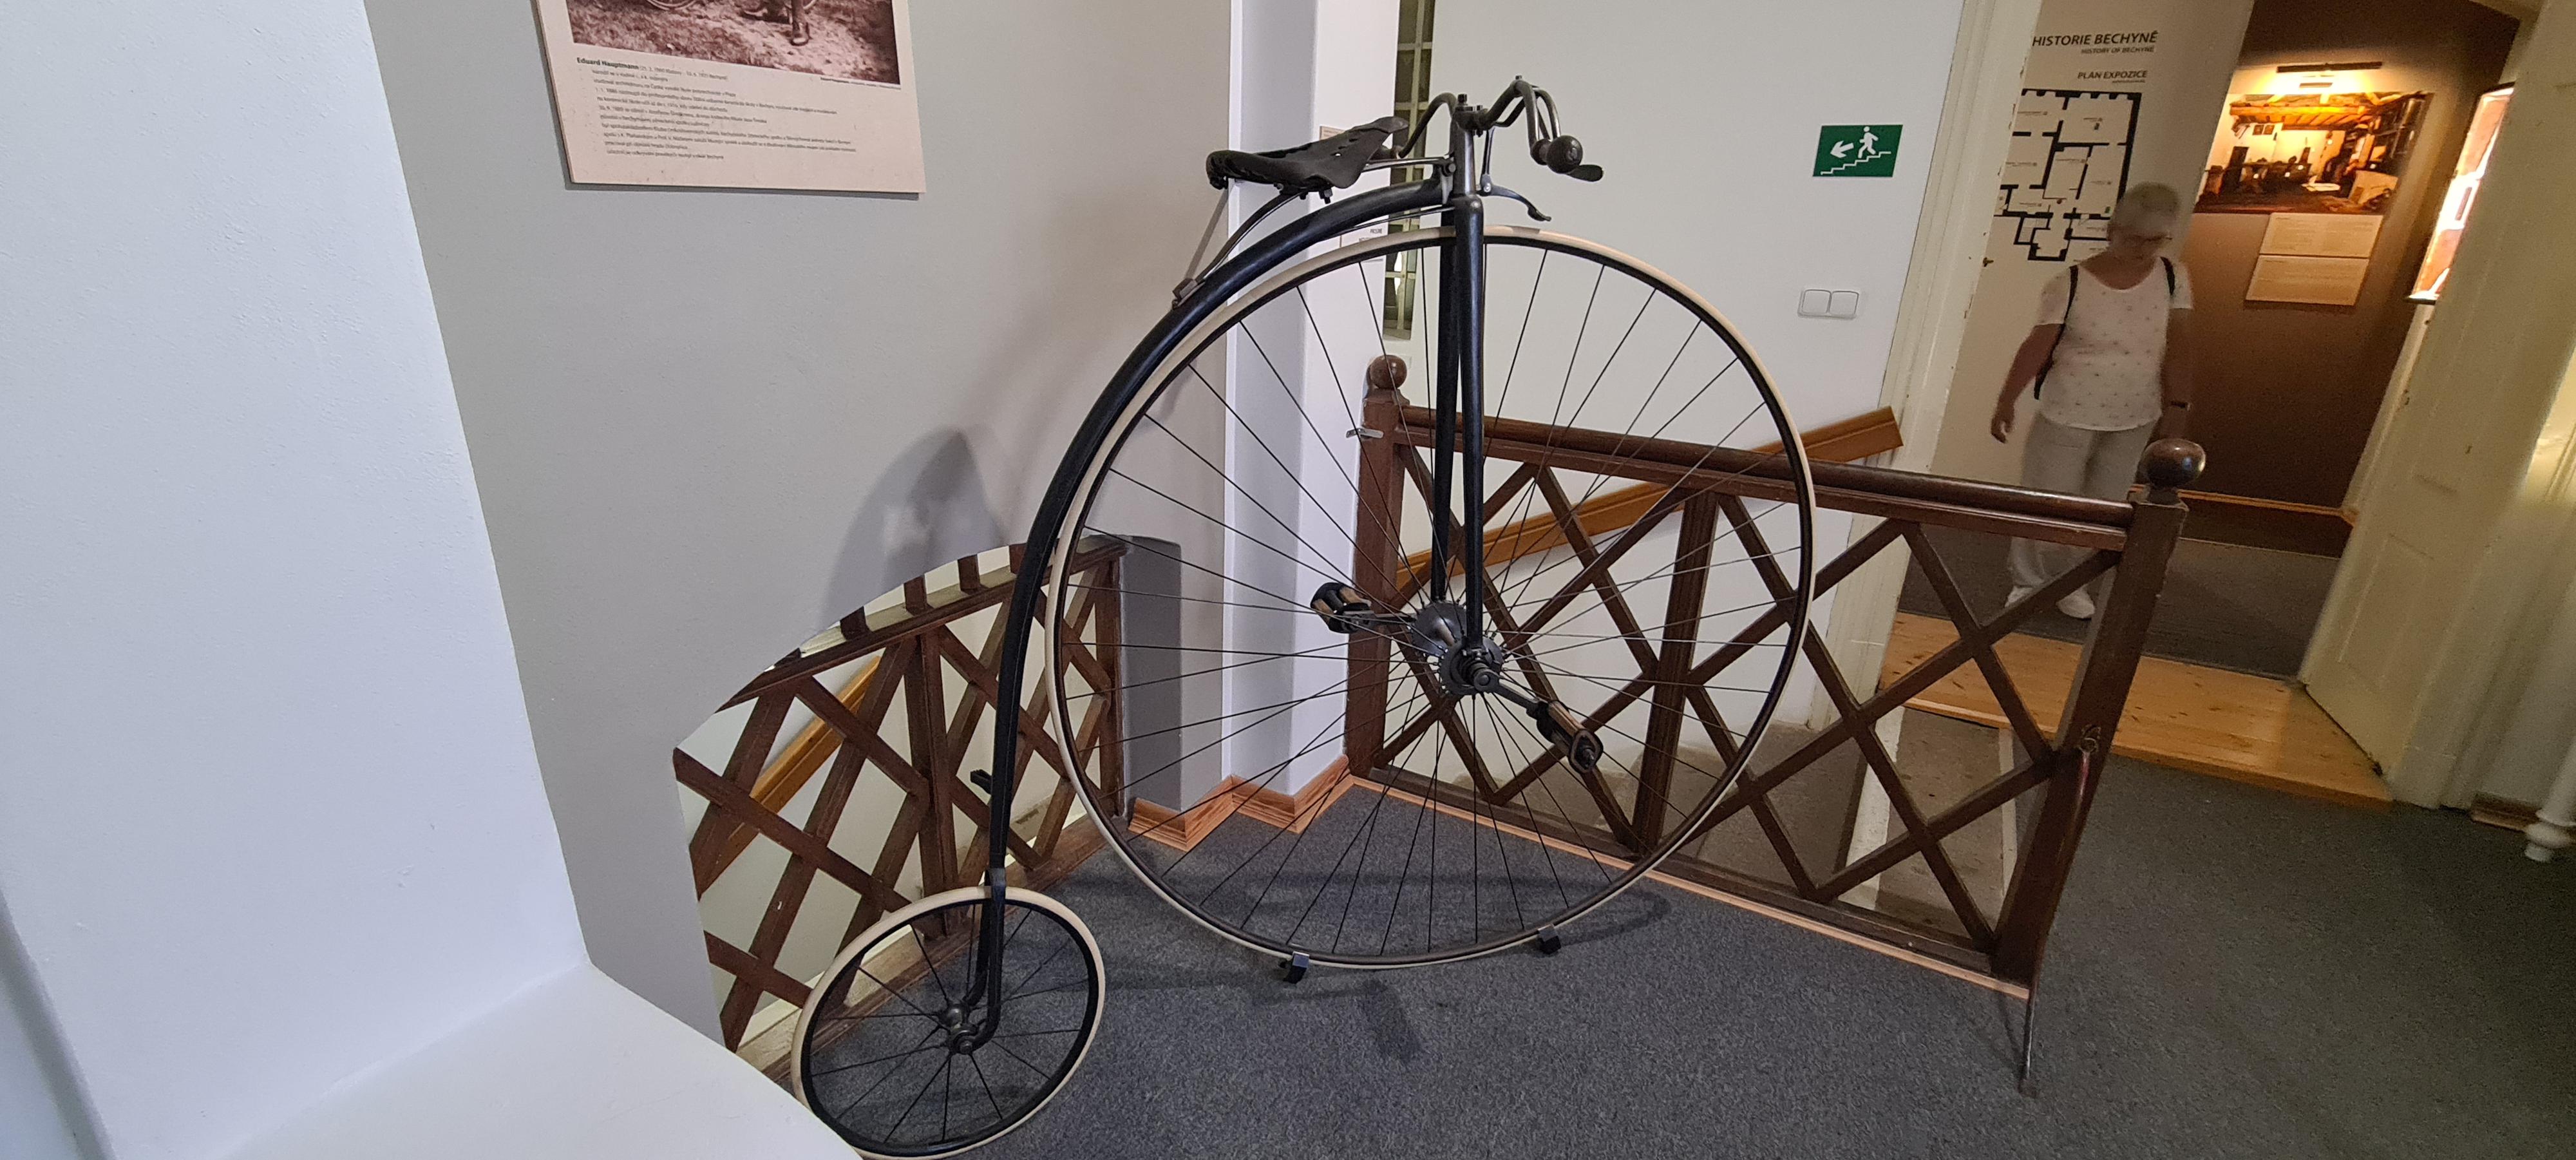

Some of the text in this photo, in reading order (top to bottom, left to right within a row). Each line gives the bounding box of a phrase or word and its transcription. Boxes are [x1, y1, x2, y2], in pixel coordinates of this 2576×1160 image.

[2032, 34, 2092, 46] HISTORIE
[577, 57, 639, 70] Eduard Hauptmann
[2103, 70, 2148, 79] EXPOZICE
